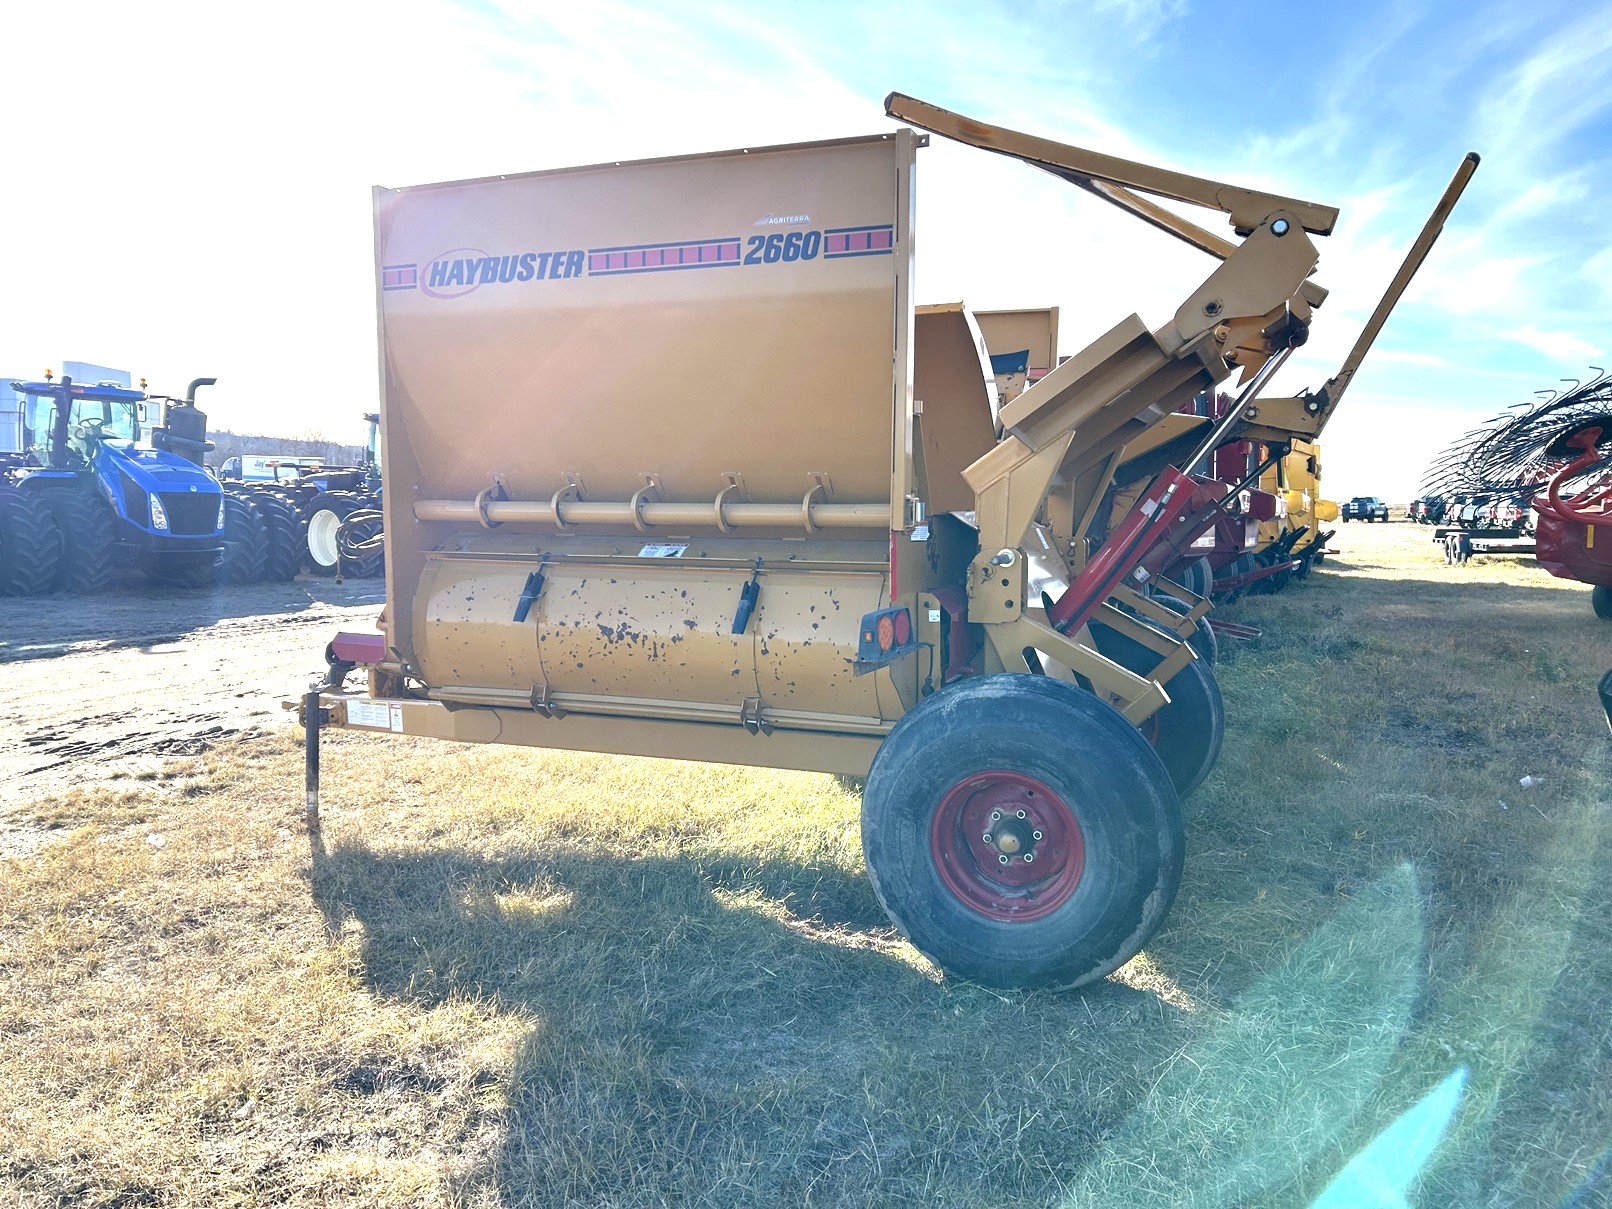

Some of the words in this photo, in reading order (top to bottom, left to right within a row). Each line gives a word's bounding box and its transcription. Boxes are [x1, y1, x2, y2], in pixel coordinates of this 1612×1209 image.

[768, 215, 810, 224] AGRITERRA
[743, 230, 822, 265] 2660
[428, 250, 585, 287] HAYBUSTER
